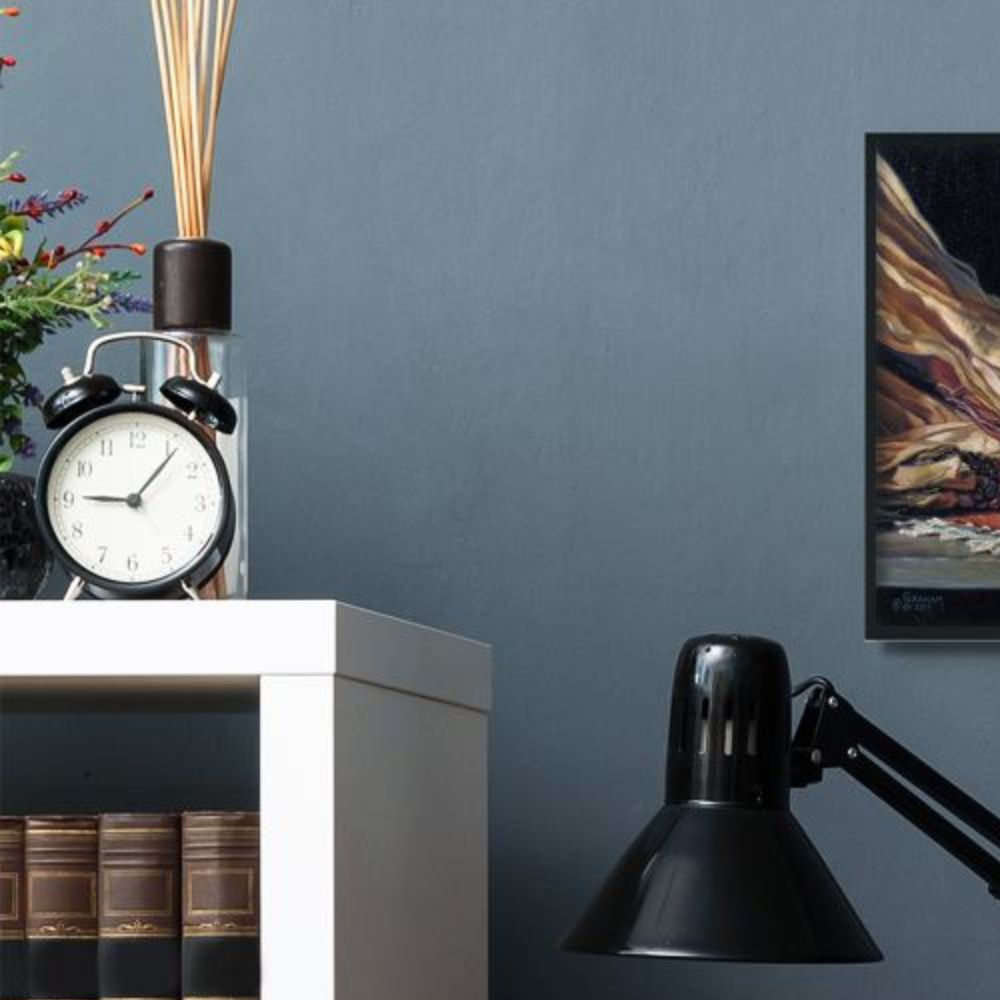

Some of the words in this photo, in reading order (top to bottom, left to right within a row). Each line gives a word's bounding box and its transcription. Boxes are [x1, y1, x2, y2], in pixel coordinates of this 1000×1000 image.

[101, 439, 113, 456] 11
[129, 431, 146, 448] 12
[77, 461, 92, 477] 10
[186, 462, 198, 479] 2
[63, 490, 74, 508] 9
[194, 495, 206, 512] 3
[71, 522, 83, 539] 8
[182, 524, 193, 541] 4
[97, 546, 108, 563] 7
[127, 554, 138, 571] 6
[161, 546, 172, 564] 5
